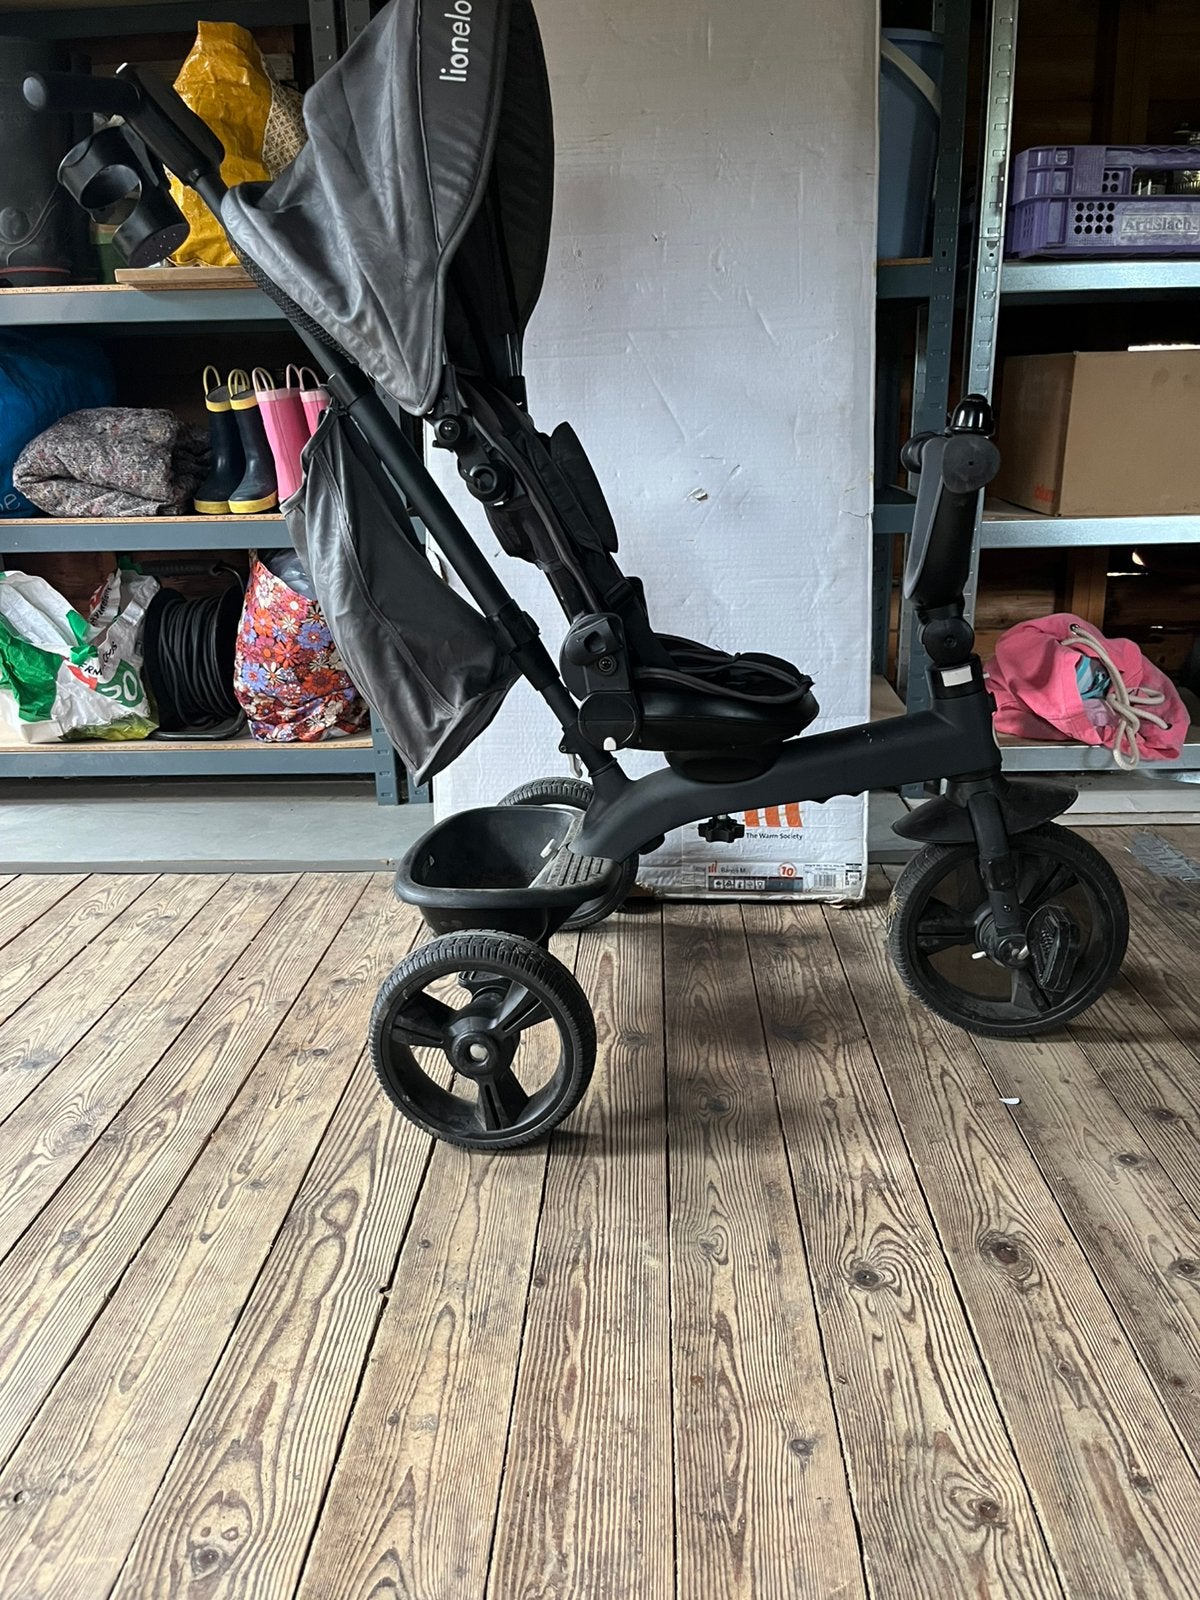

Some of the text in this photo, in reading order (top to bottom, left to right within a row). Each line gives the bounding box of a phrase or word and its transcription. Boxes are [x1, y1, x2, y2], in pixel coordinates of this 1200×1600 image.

[439, 0, 472, 82] lionelo
[779, 832, 803, 841] Society
[781, 866, 794, 877] 10
